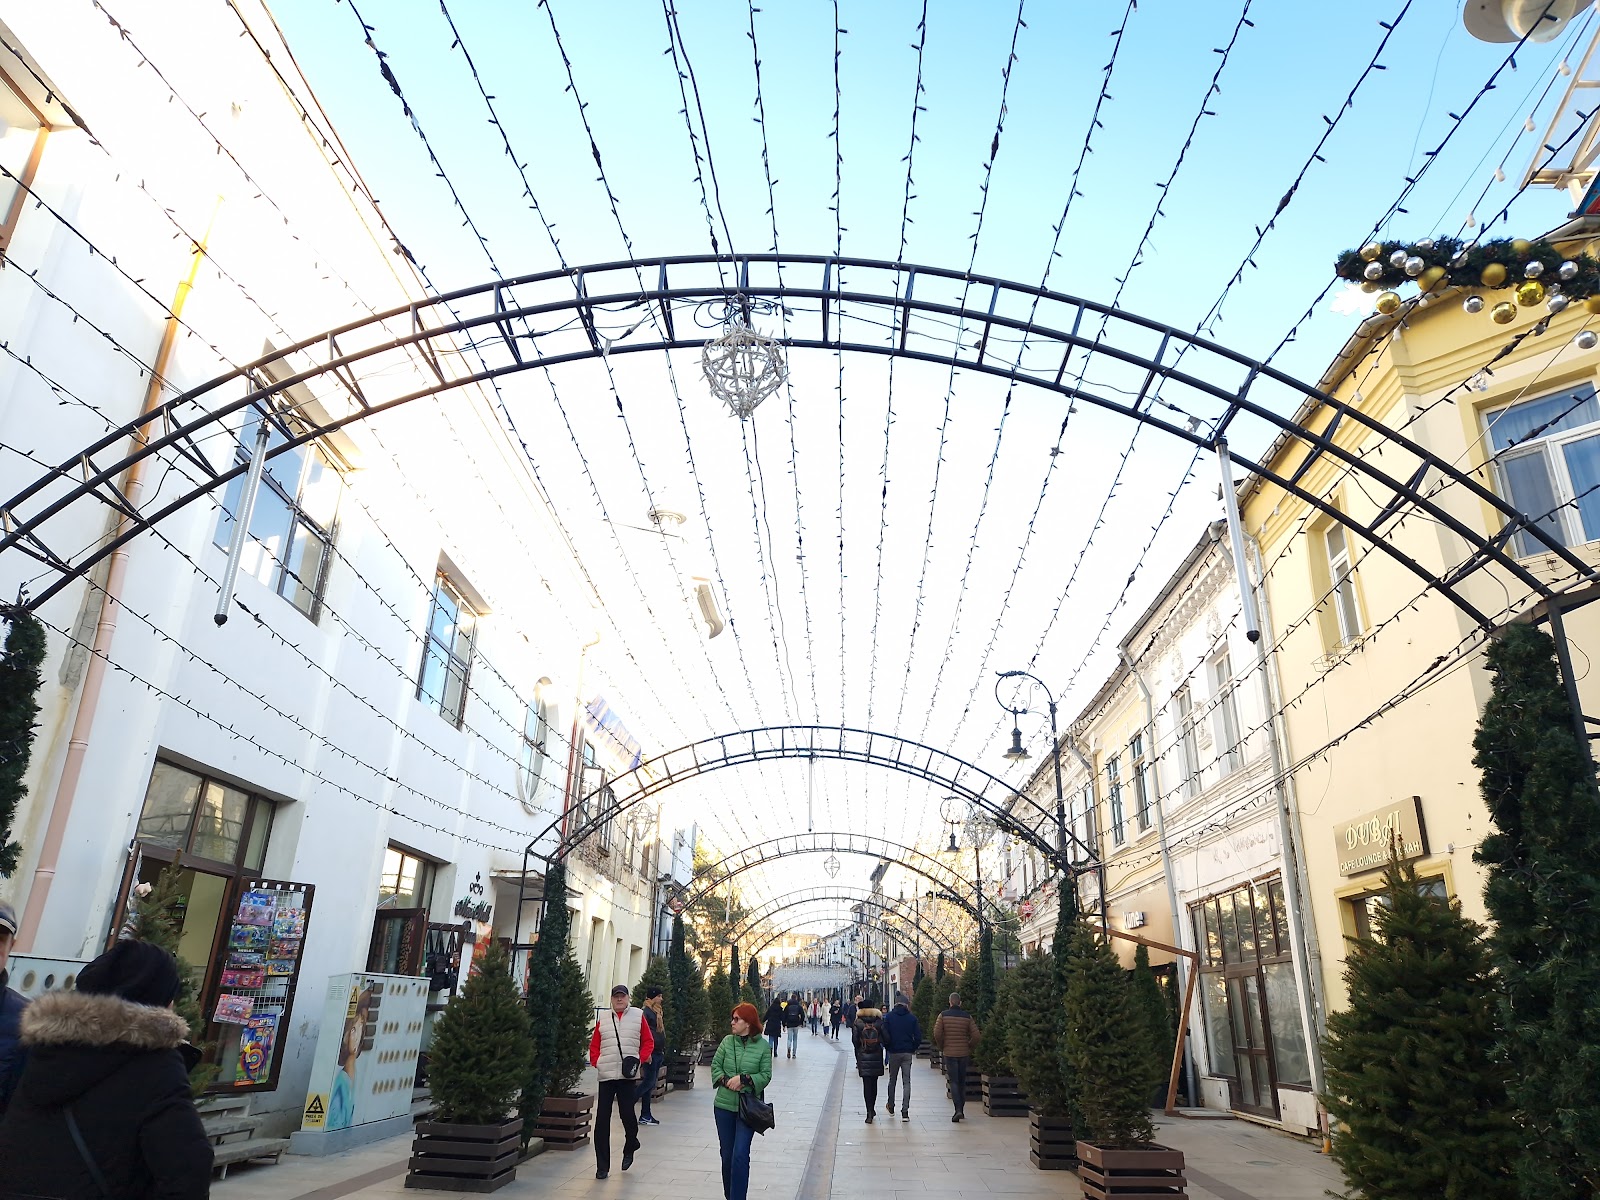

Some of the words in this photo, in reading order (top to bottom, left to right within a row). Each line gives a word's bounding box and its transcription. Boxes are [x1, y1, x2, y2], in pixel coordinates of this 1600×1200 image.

[1345, 810, 1402, 851] DUBAI
[1340, 859, 1356, 872] CAFE
[1355, 851, 1381, 868] LOUNGE
